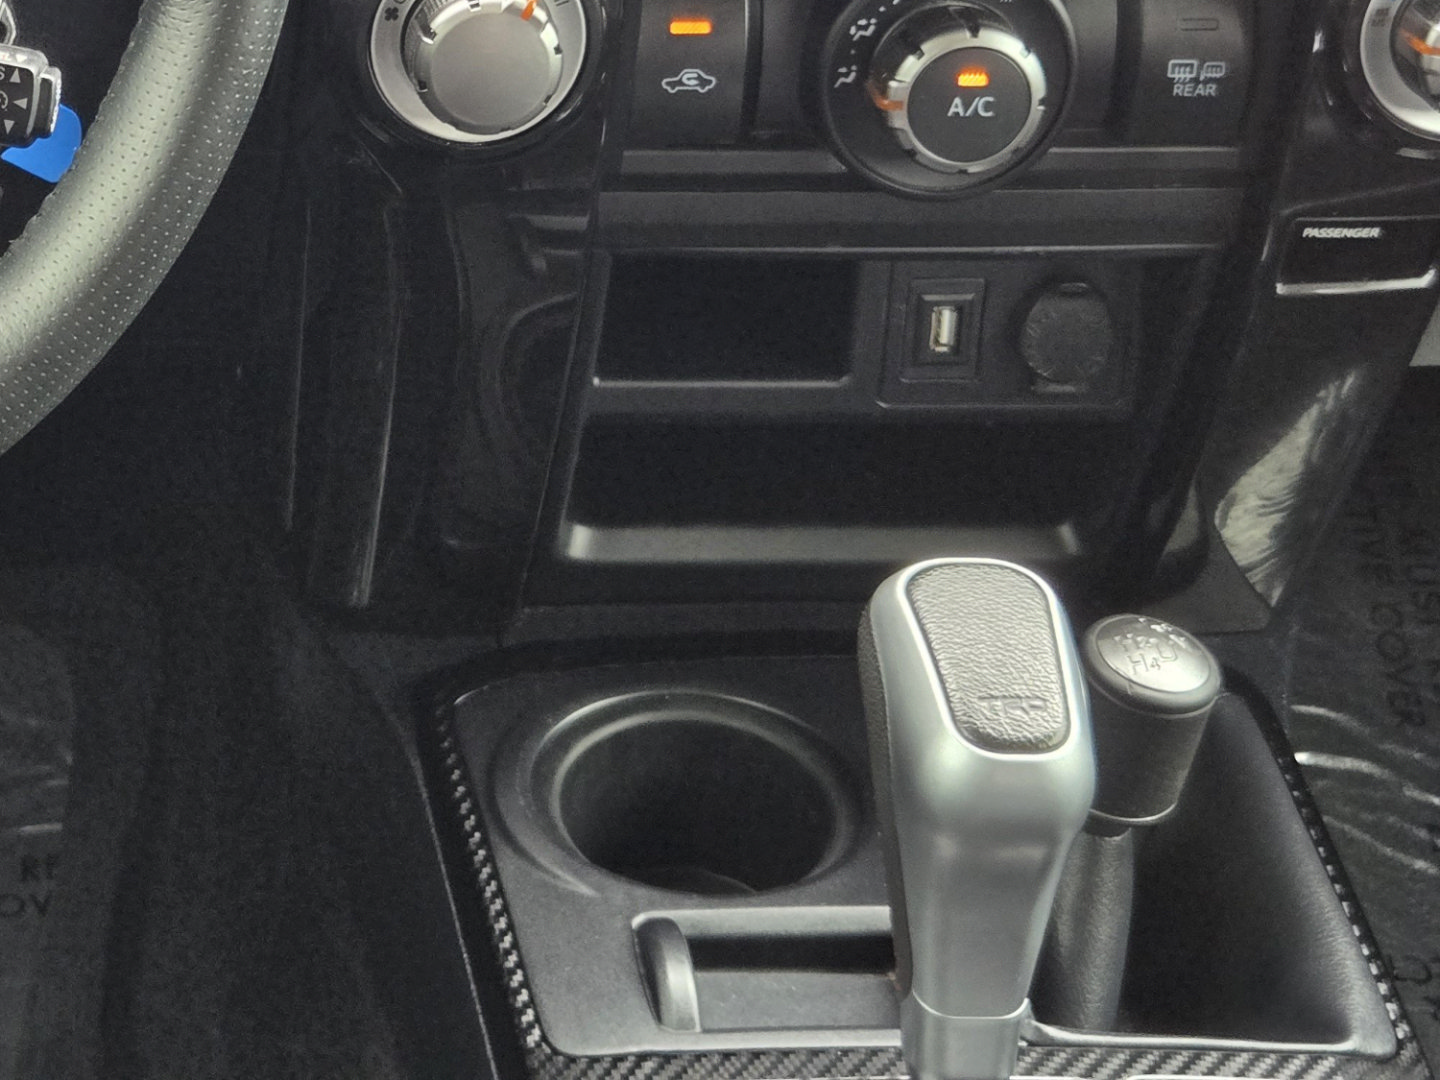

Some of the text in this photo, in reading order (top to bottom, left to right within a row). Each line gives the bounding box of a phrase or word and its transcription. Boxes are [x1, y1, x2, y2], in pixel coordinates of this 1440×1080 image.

[1173, 83, 1218, 98] REAR
[947, 96, 997, 117] A/C
[1302, 227, 1382, 239] PASSENGER
